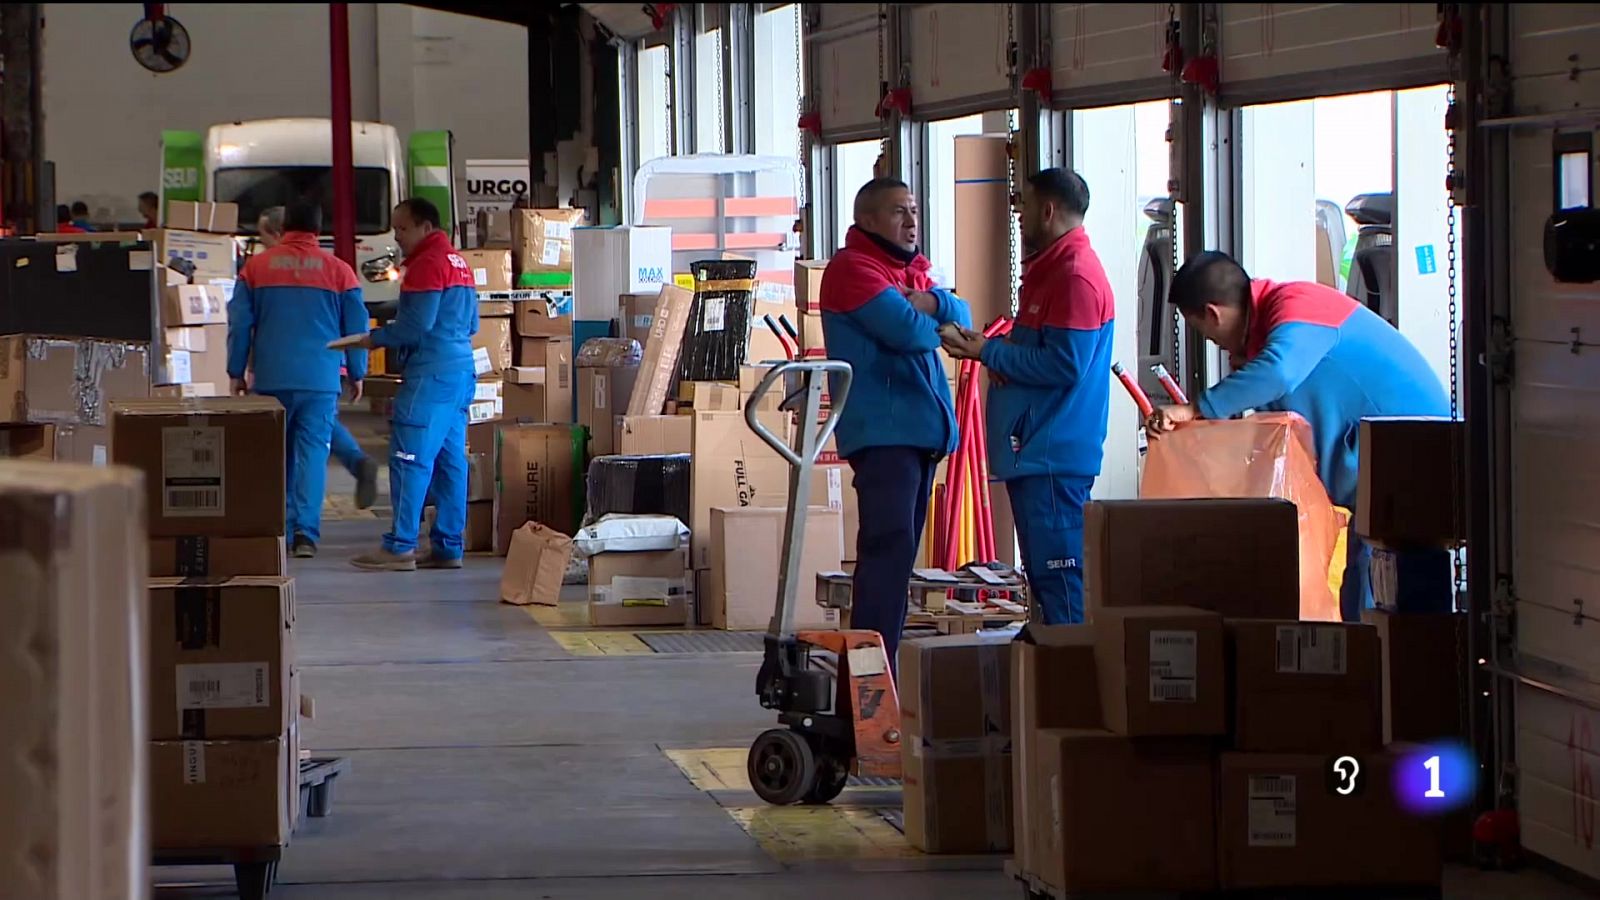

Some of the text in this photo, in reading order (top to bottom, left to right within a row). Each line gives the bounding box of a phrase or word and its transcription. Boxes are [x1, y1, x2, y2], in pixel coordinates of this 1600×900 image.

[466, 179, 528, 196] URGO
[638, 267, 663, 279] MAX
[734, 459, 746, 489] FULL
[1046, 558, 1076, 569] SEUR
